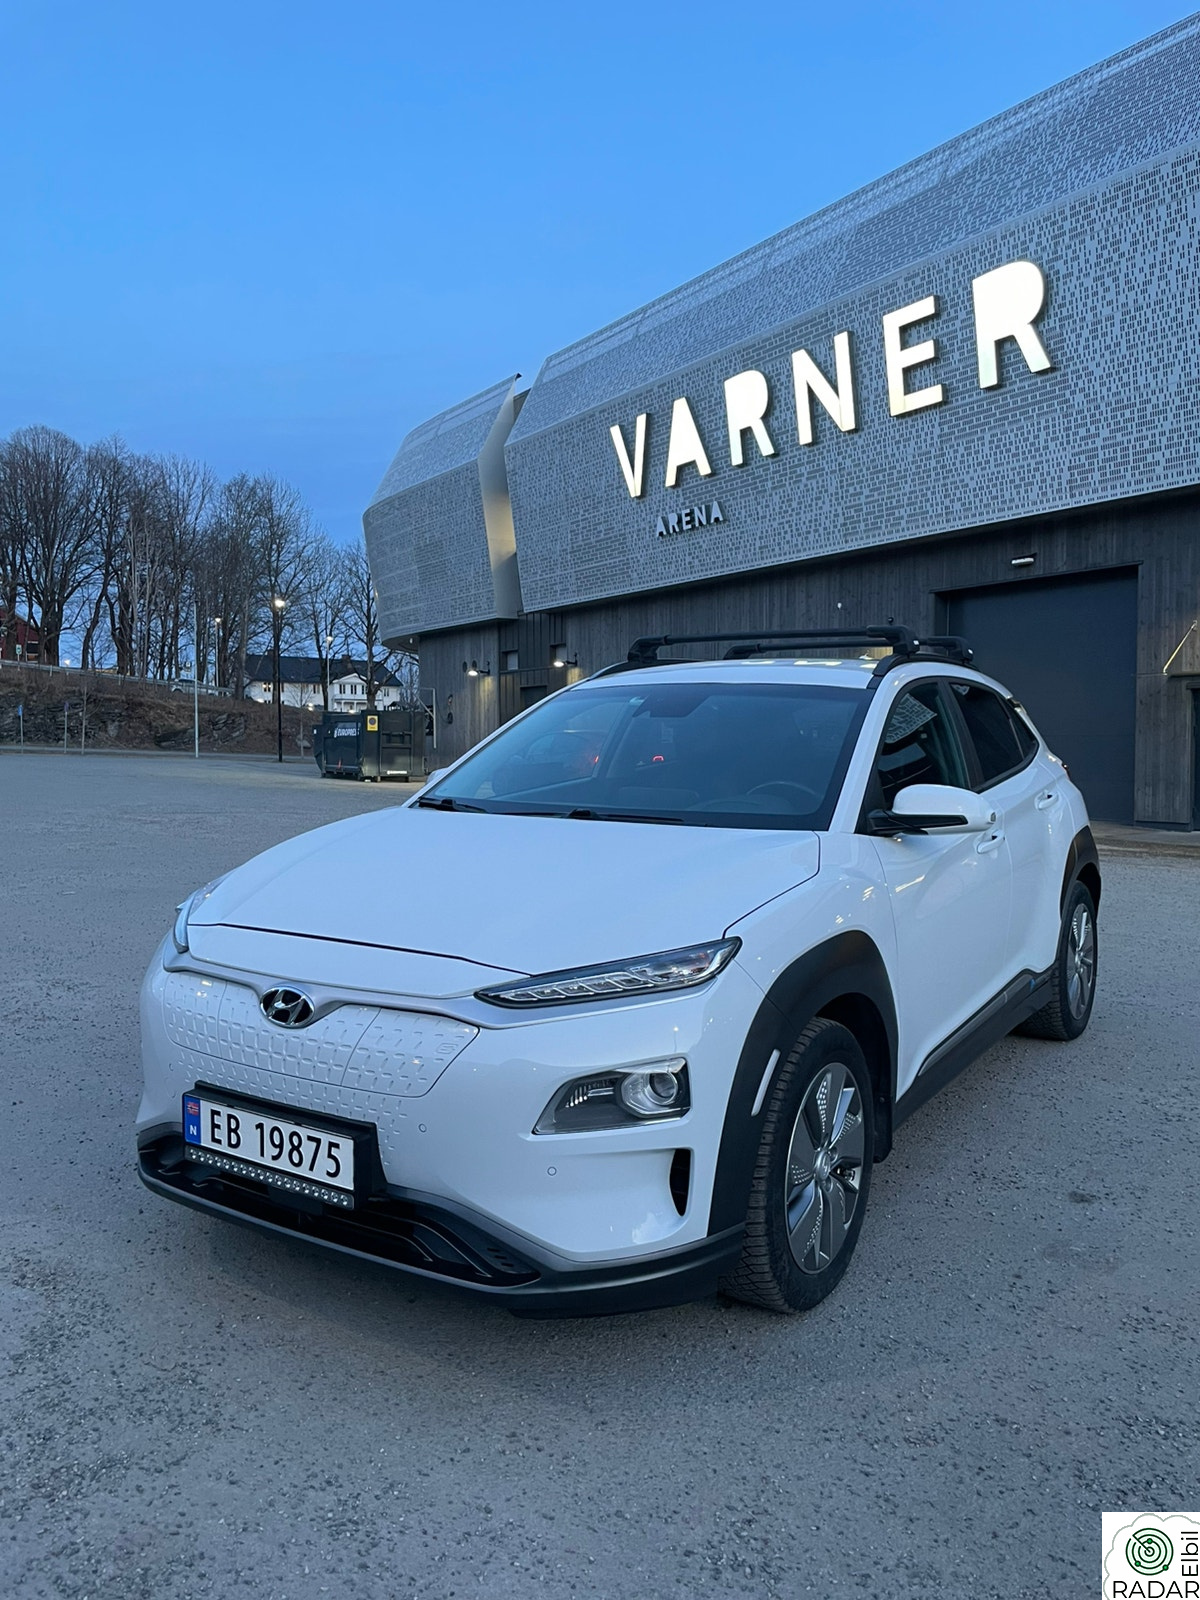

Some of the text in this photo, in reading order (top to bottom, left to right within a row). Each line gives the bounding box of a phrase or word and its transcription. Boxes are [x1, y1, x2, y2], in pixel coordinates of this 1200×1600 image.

[610, 260, 1051, 498] VARNER
[656, 500, 724, 537] ARENA
[189, 1125, 197, 1136] N
[210, 1108, 341, 1178] EB 19875
